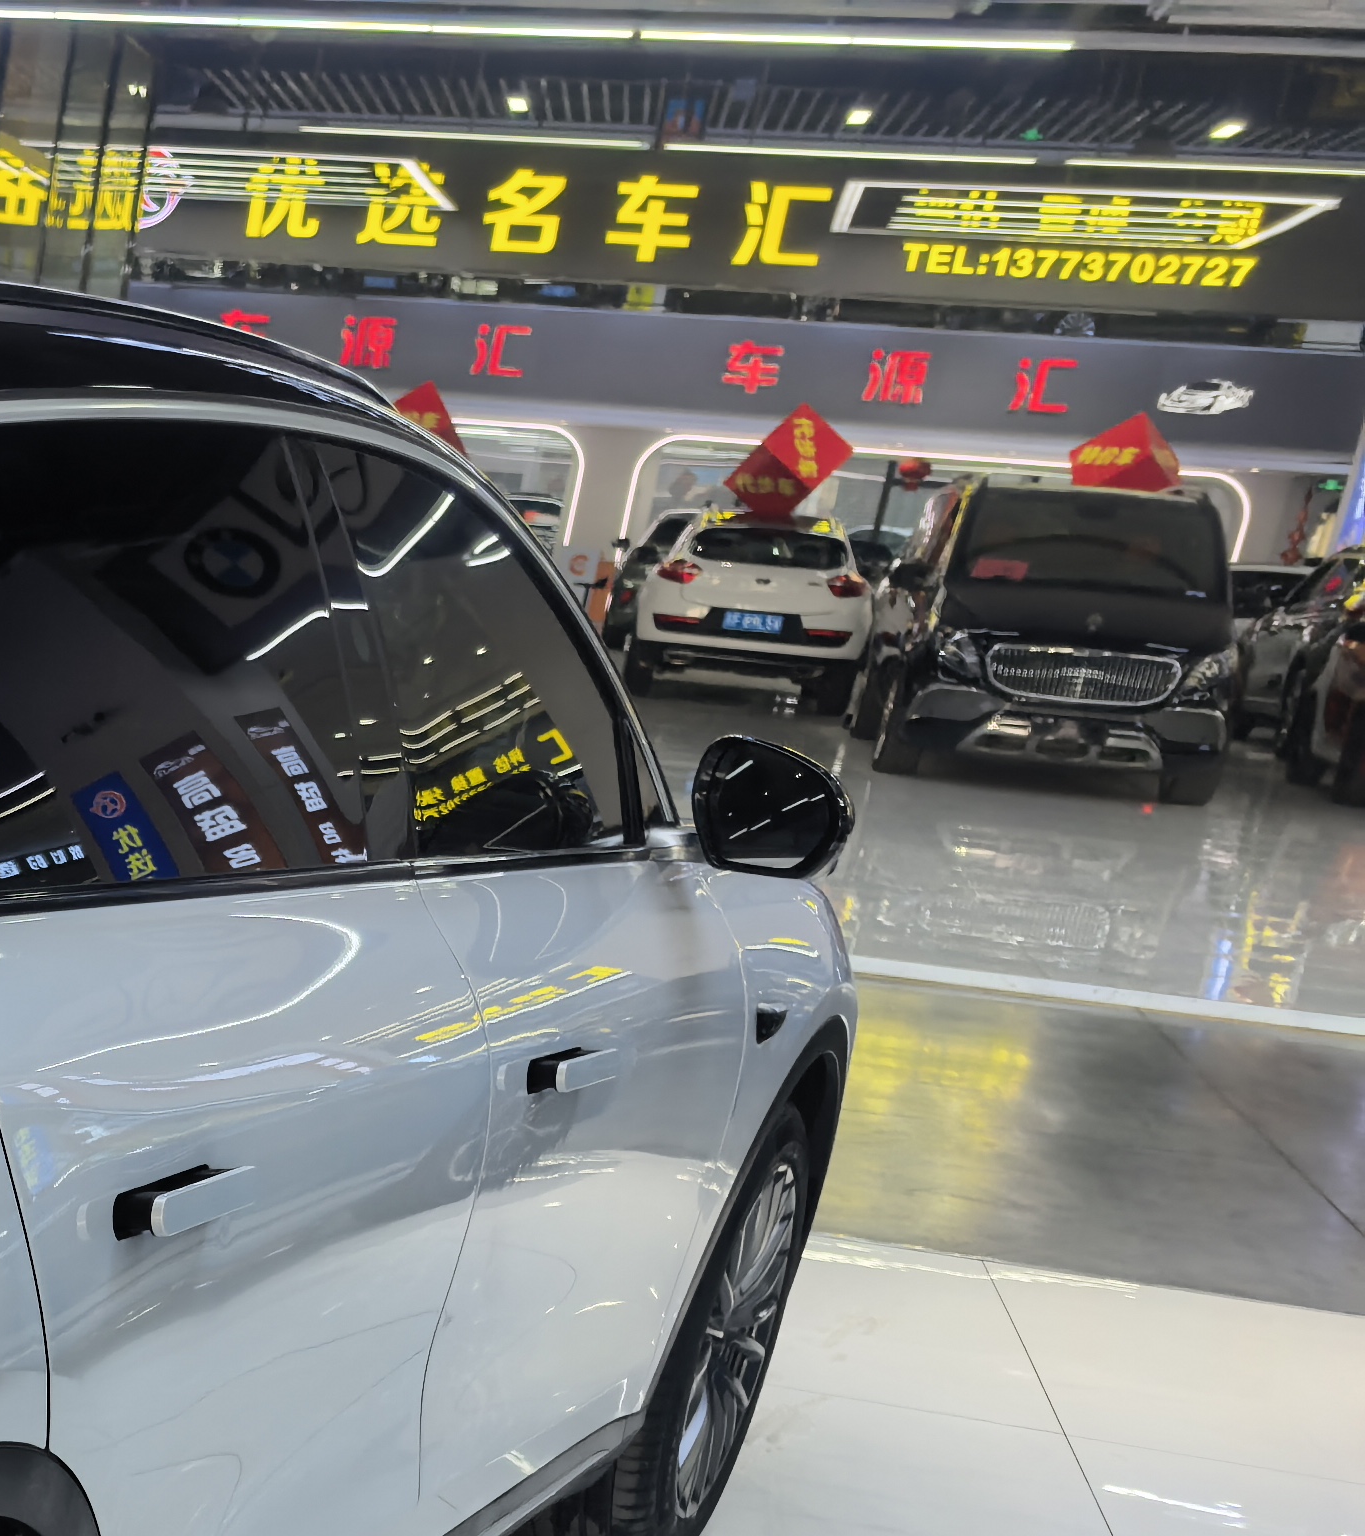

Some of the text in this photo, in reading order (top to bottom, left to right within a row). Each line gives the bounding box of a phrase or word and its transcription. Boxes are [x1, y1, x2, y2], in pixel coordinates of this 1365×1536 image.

[245, 156, 833, 268] 优选名车汇
[902, 242, 1259, 288] TEL:13773702727
[721, 340, 1079, 413] 车源汇
